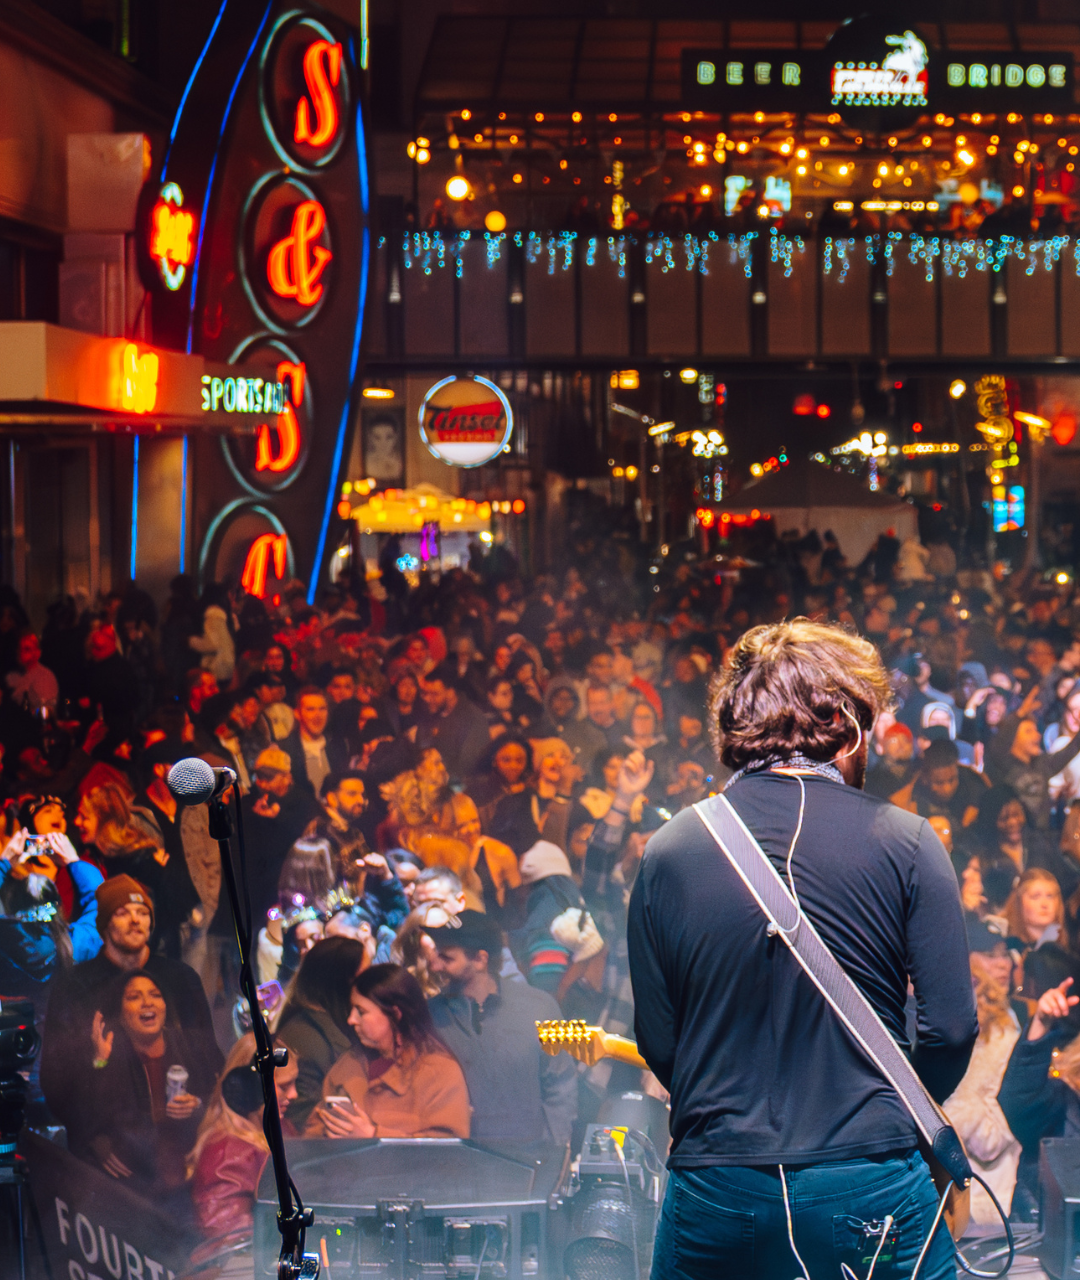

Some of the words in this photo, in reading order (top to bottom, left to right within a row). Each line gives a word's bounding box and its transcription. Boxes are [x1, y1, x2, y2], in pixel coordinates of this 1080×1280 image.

[696, 61, 800, 87] BEER
[947, 63, 1067, 88] BRIDGE
[201, 375, 264, 413] SPORTS
